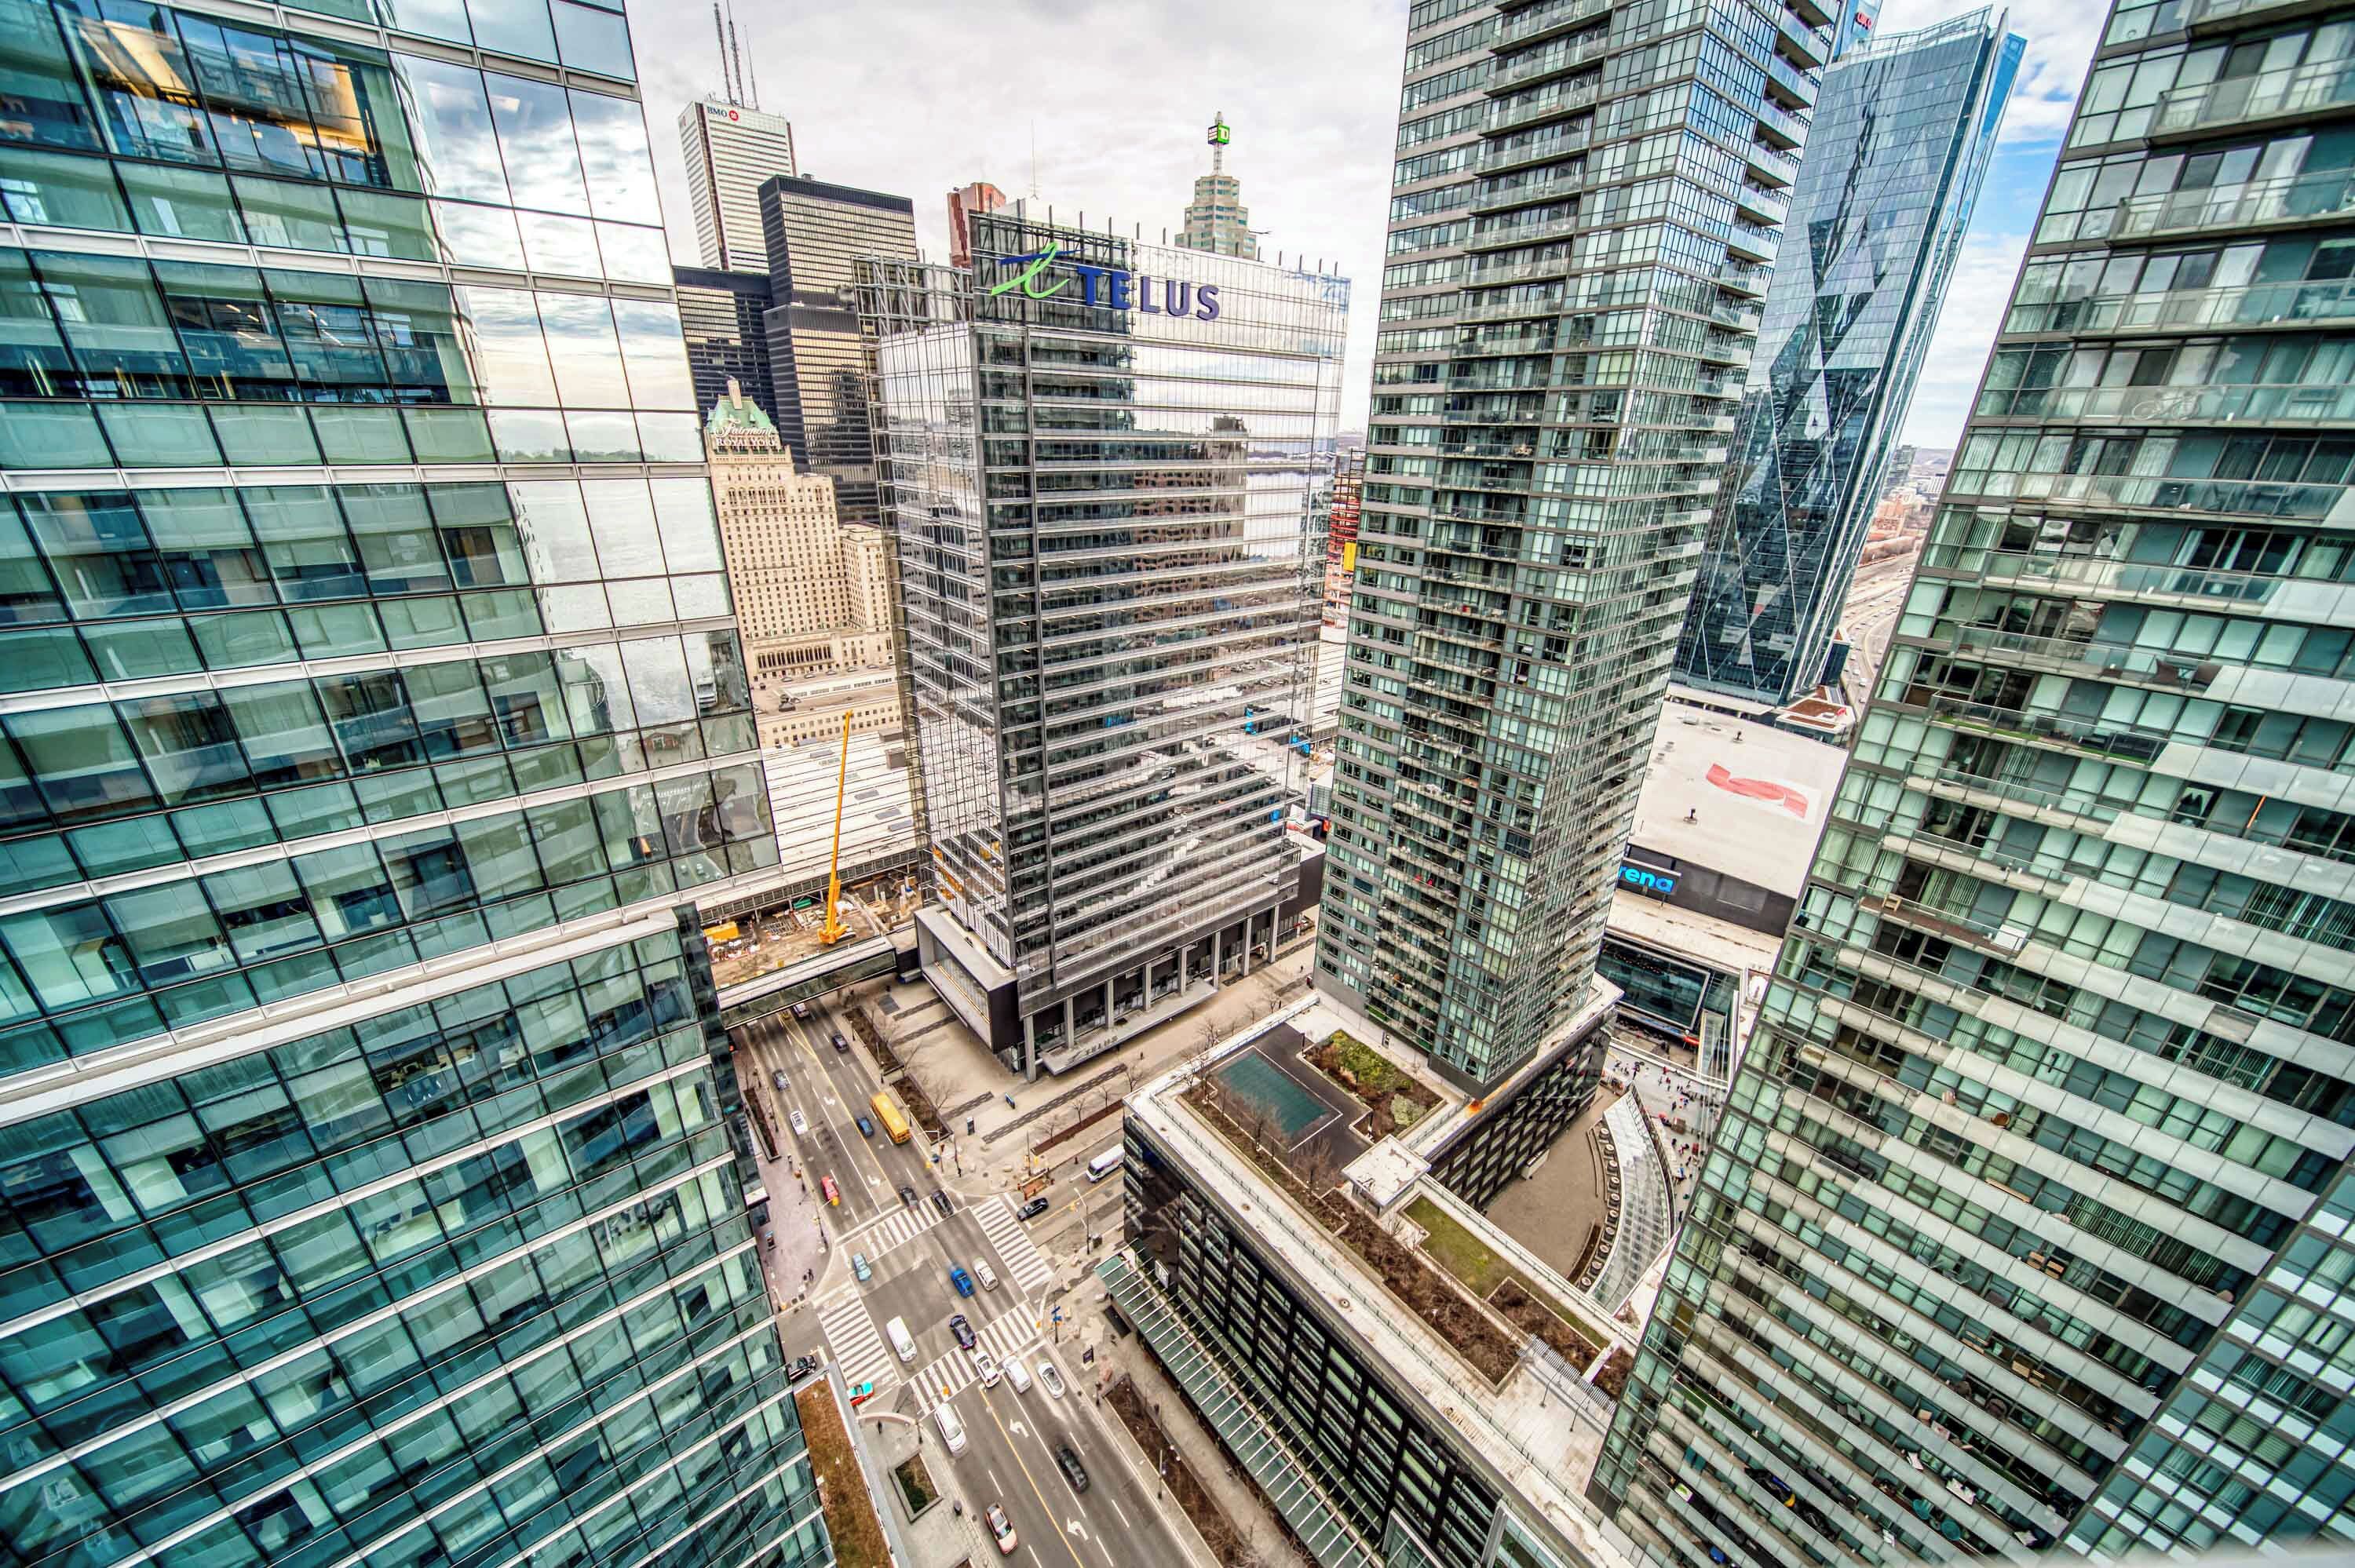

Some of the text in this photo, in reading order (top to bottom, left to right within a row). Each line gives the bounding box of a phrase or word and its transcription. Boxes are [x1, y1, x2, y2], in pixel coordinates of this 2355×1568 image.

[707, 106, 728, 117] BMO
[1218, 126, 1229, 140] TD
[1077, 265, 1220, 320] TELUS
[1618, 866, 1674, 892] rena
